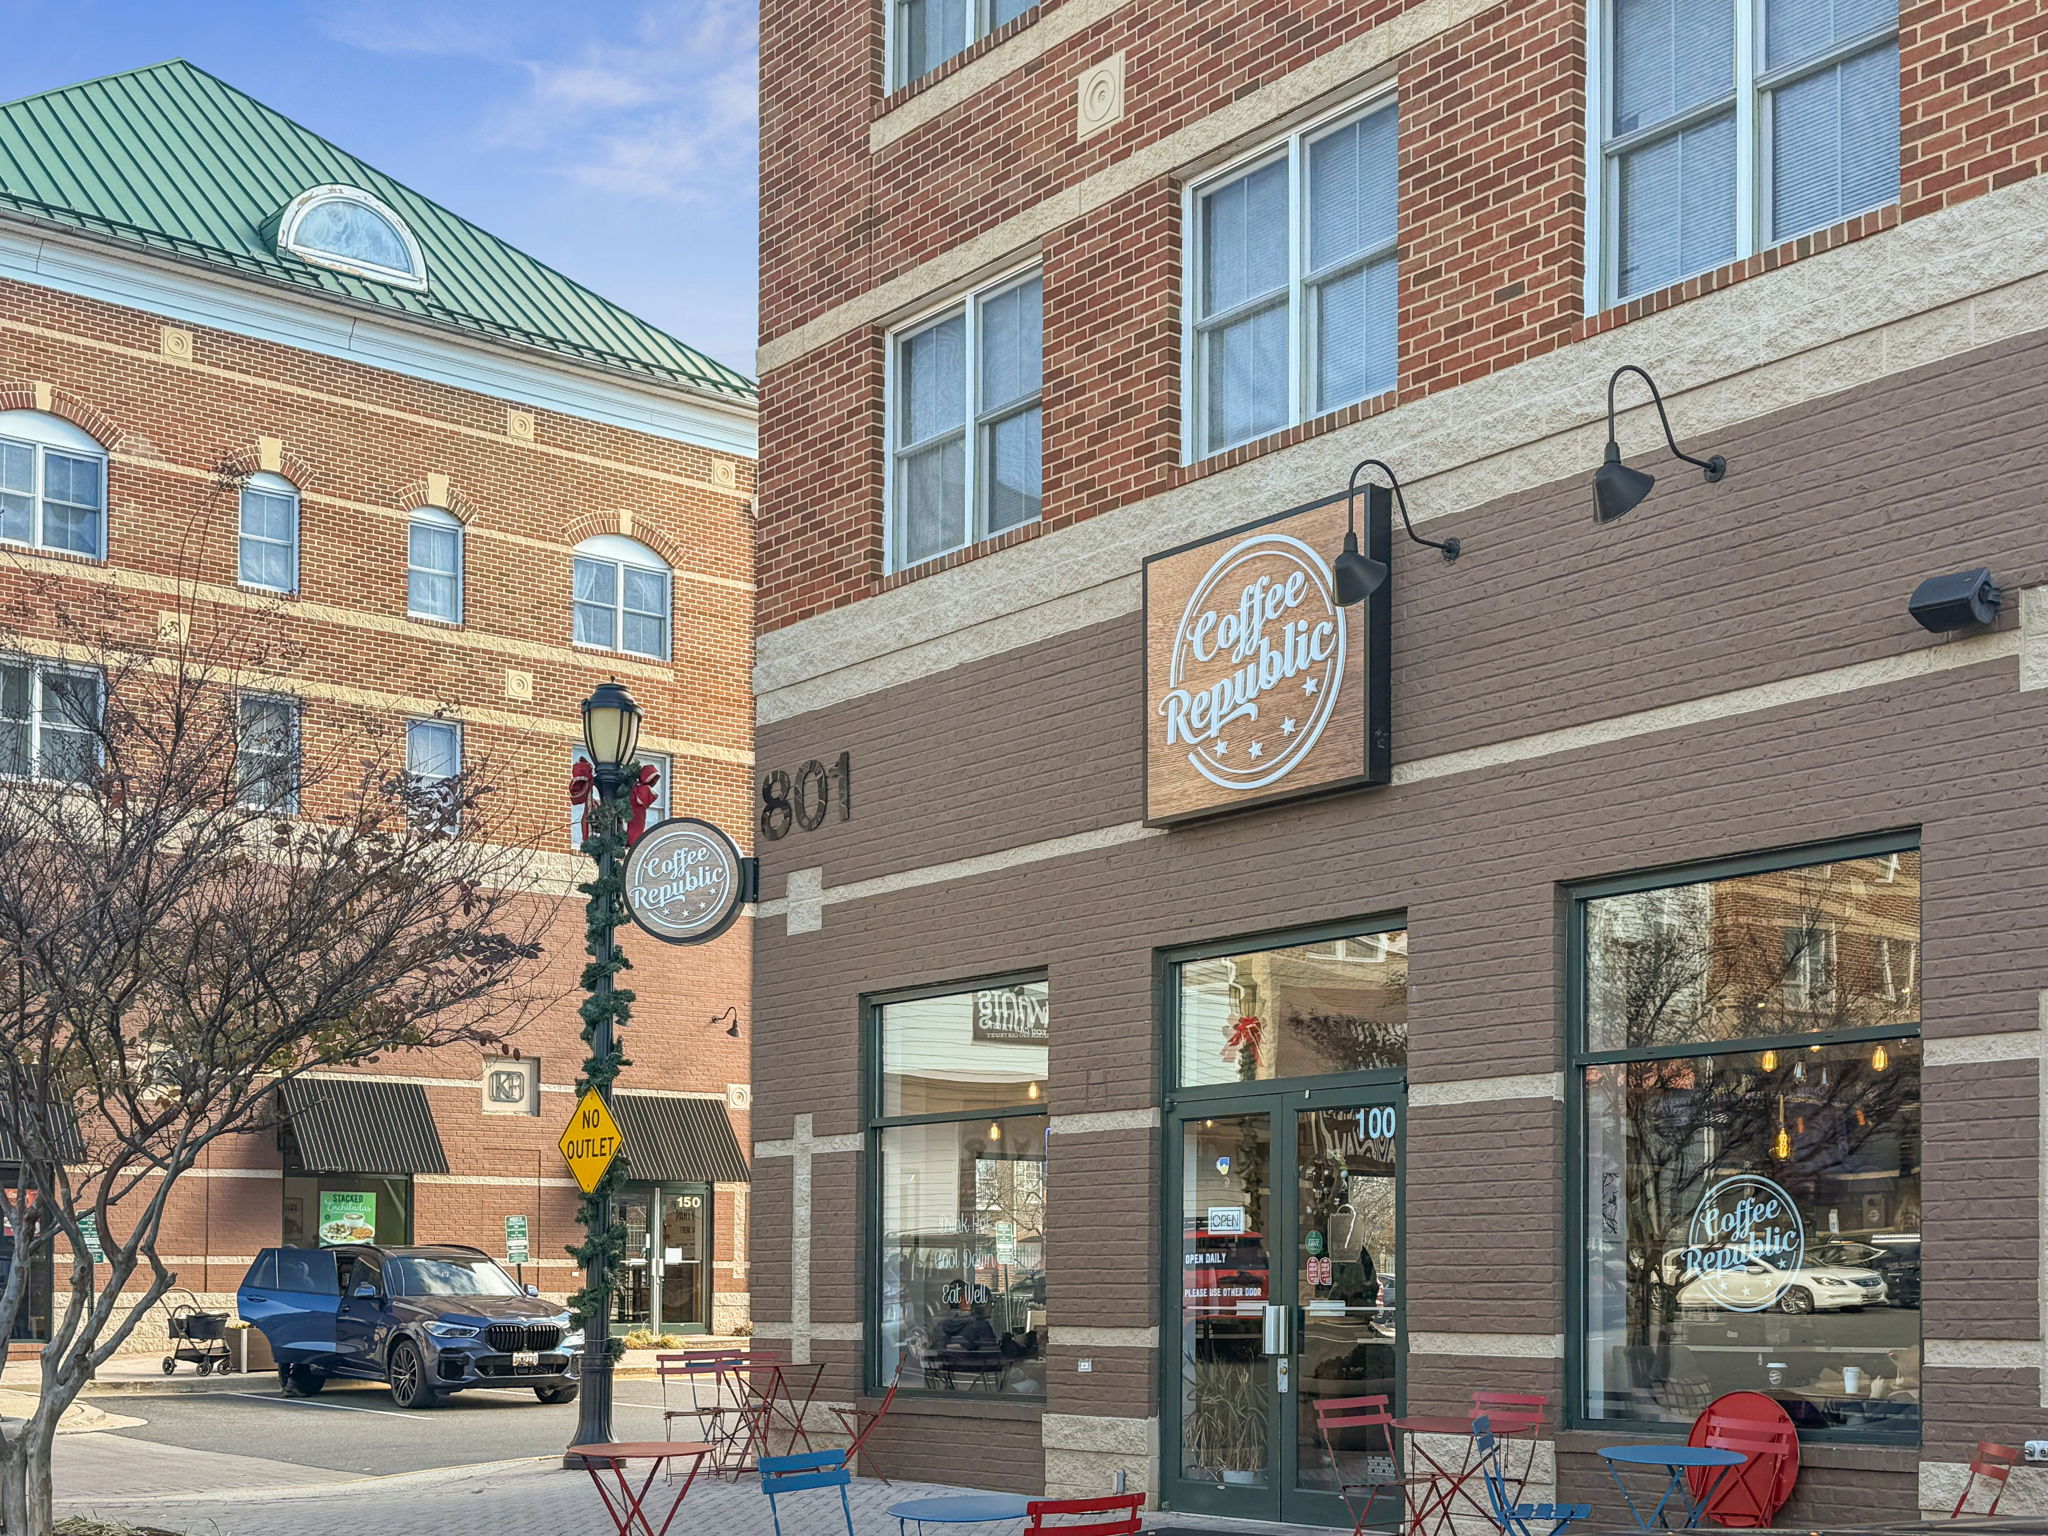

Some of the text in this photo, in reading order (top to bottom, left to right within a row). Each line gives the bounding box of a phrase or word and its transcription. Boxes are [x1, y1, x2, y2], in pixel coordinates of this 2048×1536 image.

[1186, 571, 1309, 664] Coffee
[1159, 620, 1337, 745] Republic
[761, 751, 849, 840] 801
[643, 847, 710, 880] Coffee
[629, 866, 726, 910] Republic
[582, 1108, 600, 1129] NO
[1355, 1107, 1396, 1139] 100
[567, 1137, 614, 1159] OUTLET
[325, 1200, 371, 1213] Enchiladas
[333, 1194, 363, 1203] STACKED
[676, 1196, 701, 1208] 150
[1212, 1214, 1238, 1227] OPEN
[1700, 1197, 1781, 1241] Coffee
[962, 1248, 997, 1269] Down
[1185, 1252, 1227, 1264] OPEN DAILY
[1680, 1226, 1799, 1280] Republic
[942, 1283, 989, 1305] Eat Well
[1184, 1287, 1262, 1297] PLEASE USE OTHER DOOR
